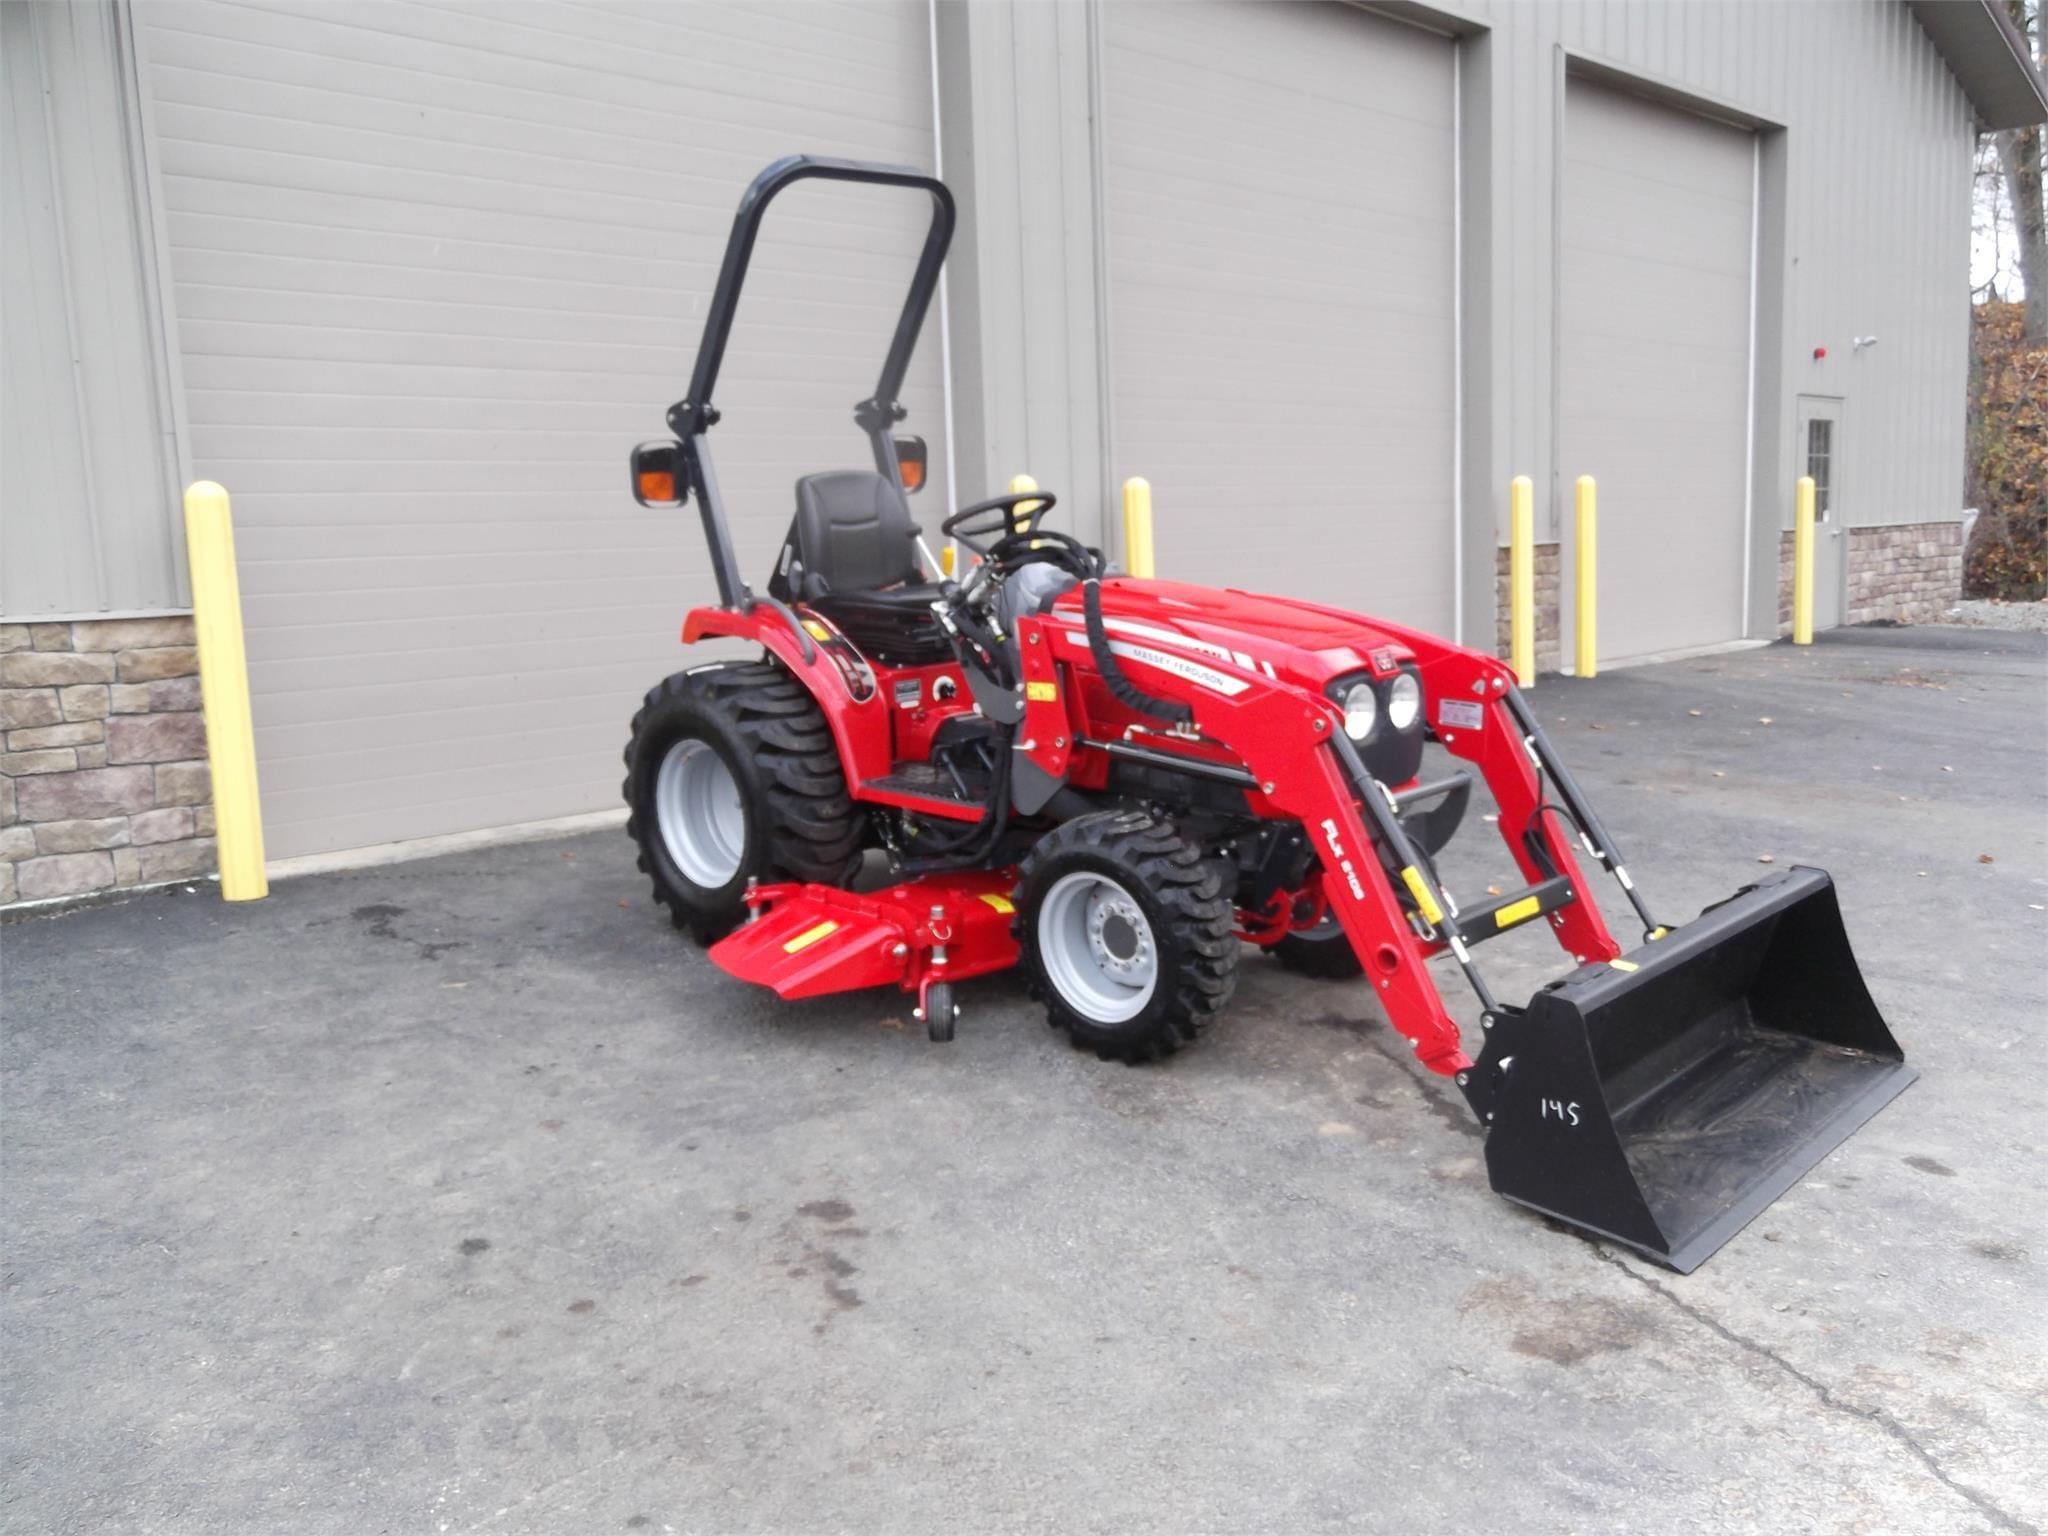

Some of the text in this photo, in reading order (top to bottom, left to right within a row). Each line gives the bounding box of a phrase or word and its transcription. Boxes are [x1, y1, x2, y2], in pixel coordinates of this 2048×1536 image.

[1132, 648, 1171, 665] MASSEY
[1174, 661, 1225, 687] FERGUSON
[1541, 1097, 1581, 1127] 145
